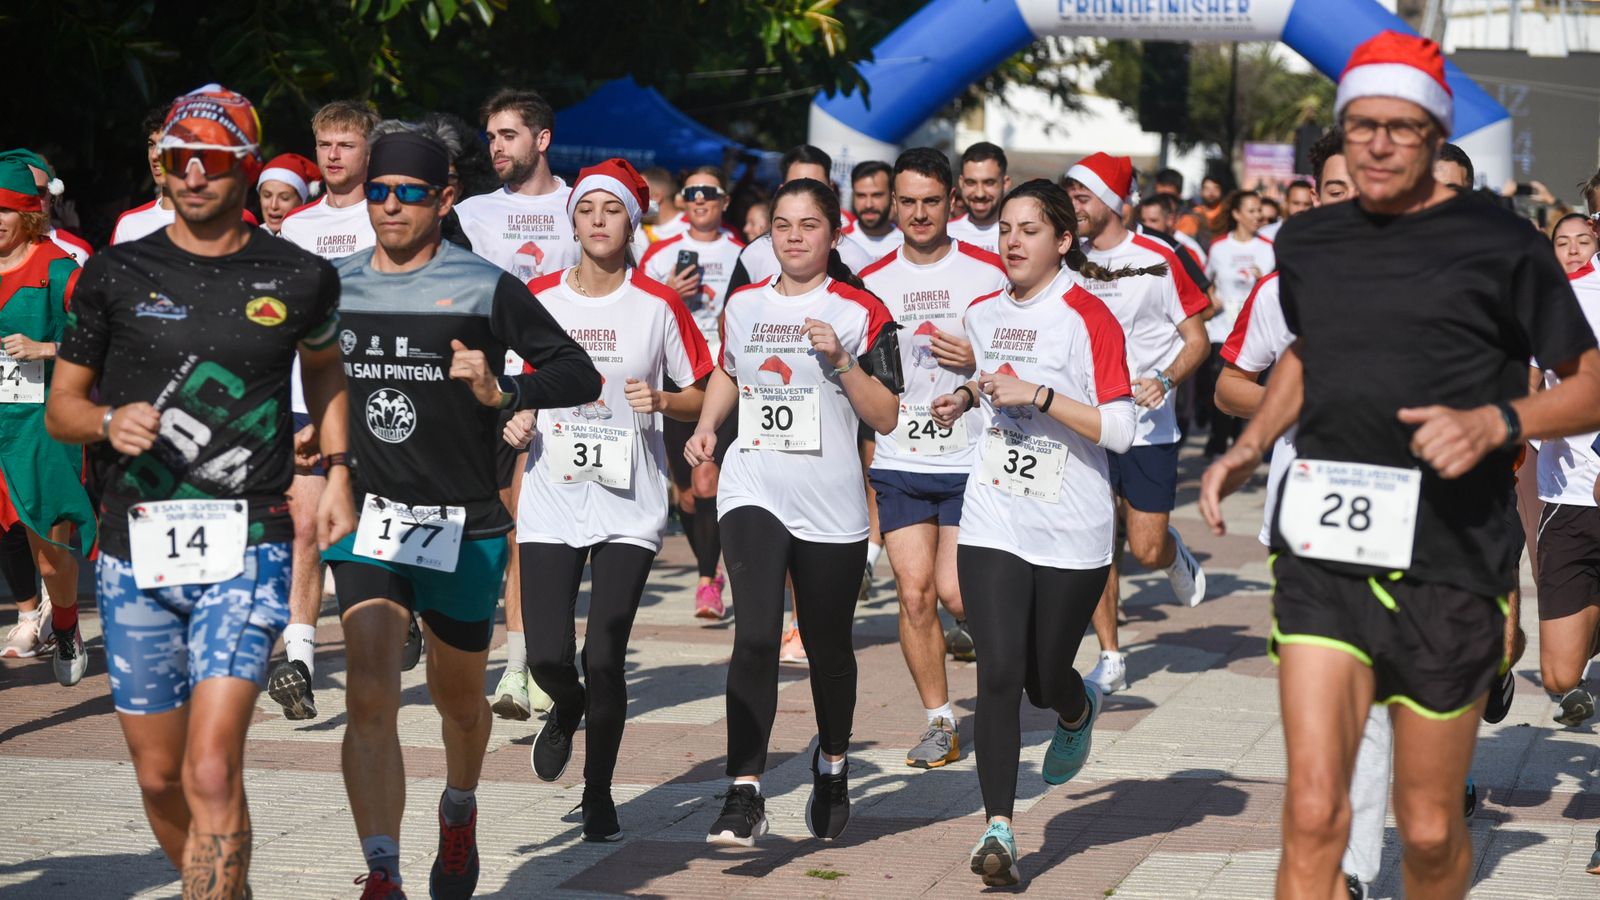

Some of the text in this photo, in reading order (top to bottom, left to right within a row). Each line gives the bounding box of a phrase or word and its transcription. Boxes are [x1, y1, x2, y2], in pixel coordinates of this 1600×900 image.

[516, 215, 554, 224] CARRERA
[323, 235, 357, 246] CARRERA
[317, 245, 356, 254] SAN SILVESTRE
[910, 290, 950, 303] CARRERA
[904, 301, 951, 313] SAN SILVESTRE
[570, 329, 616, 341] CARRERA
[761, 324, 801, 334] CARRER
[1001, 328, 1037, 342] CARRERA
[751, 334, 804, 343] SAN SILVESTRE
[991, 340, 1035, 352] SAN SILVESTRE
[353, 362, 381, 379] SAN
[384, 363, 444, 381] PINTEÑA
[774, 387, 814, 395] SILVESTRE
[762, 394, 788, 402] TARIFEÑA
[761, 405, 793, 431] 30
[571, 425, 587, 433] SAN
[589, 426, 628, 437] SILVESTRE
[573, 432, 602, 440] TARIFEÑA
[1008, 430, 1023, 440] SAN
[1024, 434, 1063, 450] SILVESTRE
[573, 442, 603, 468] 31
[1004, 449, 1037, 480] 32
[1326, 466, 1348, 475] SAN
[1351, 469, 1410, 483] SILVESTRE
[162, 503, 183, 512] SAN
[1320, 493, 1371, 531] 28
[378, 518, 445, 549] 177
[166, 525, 208, 558] 14
